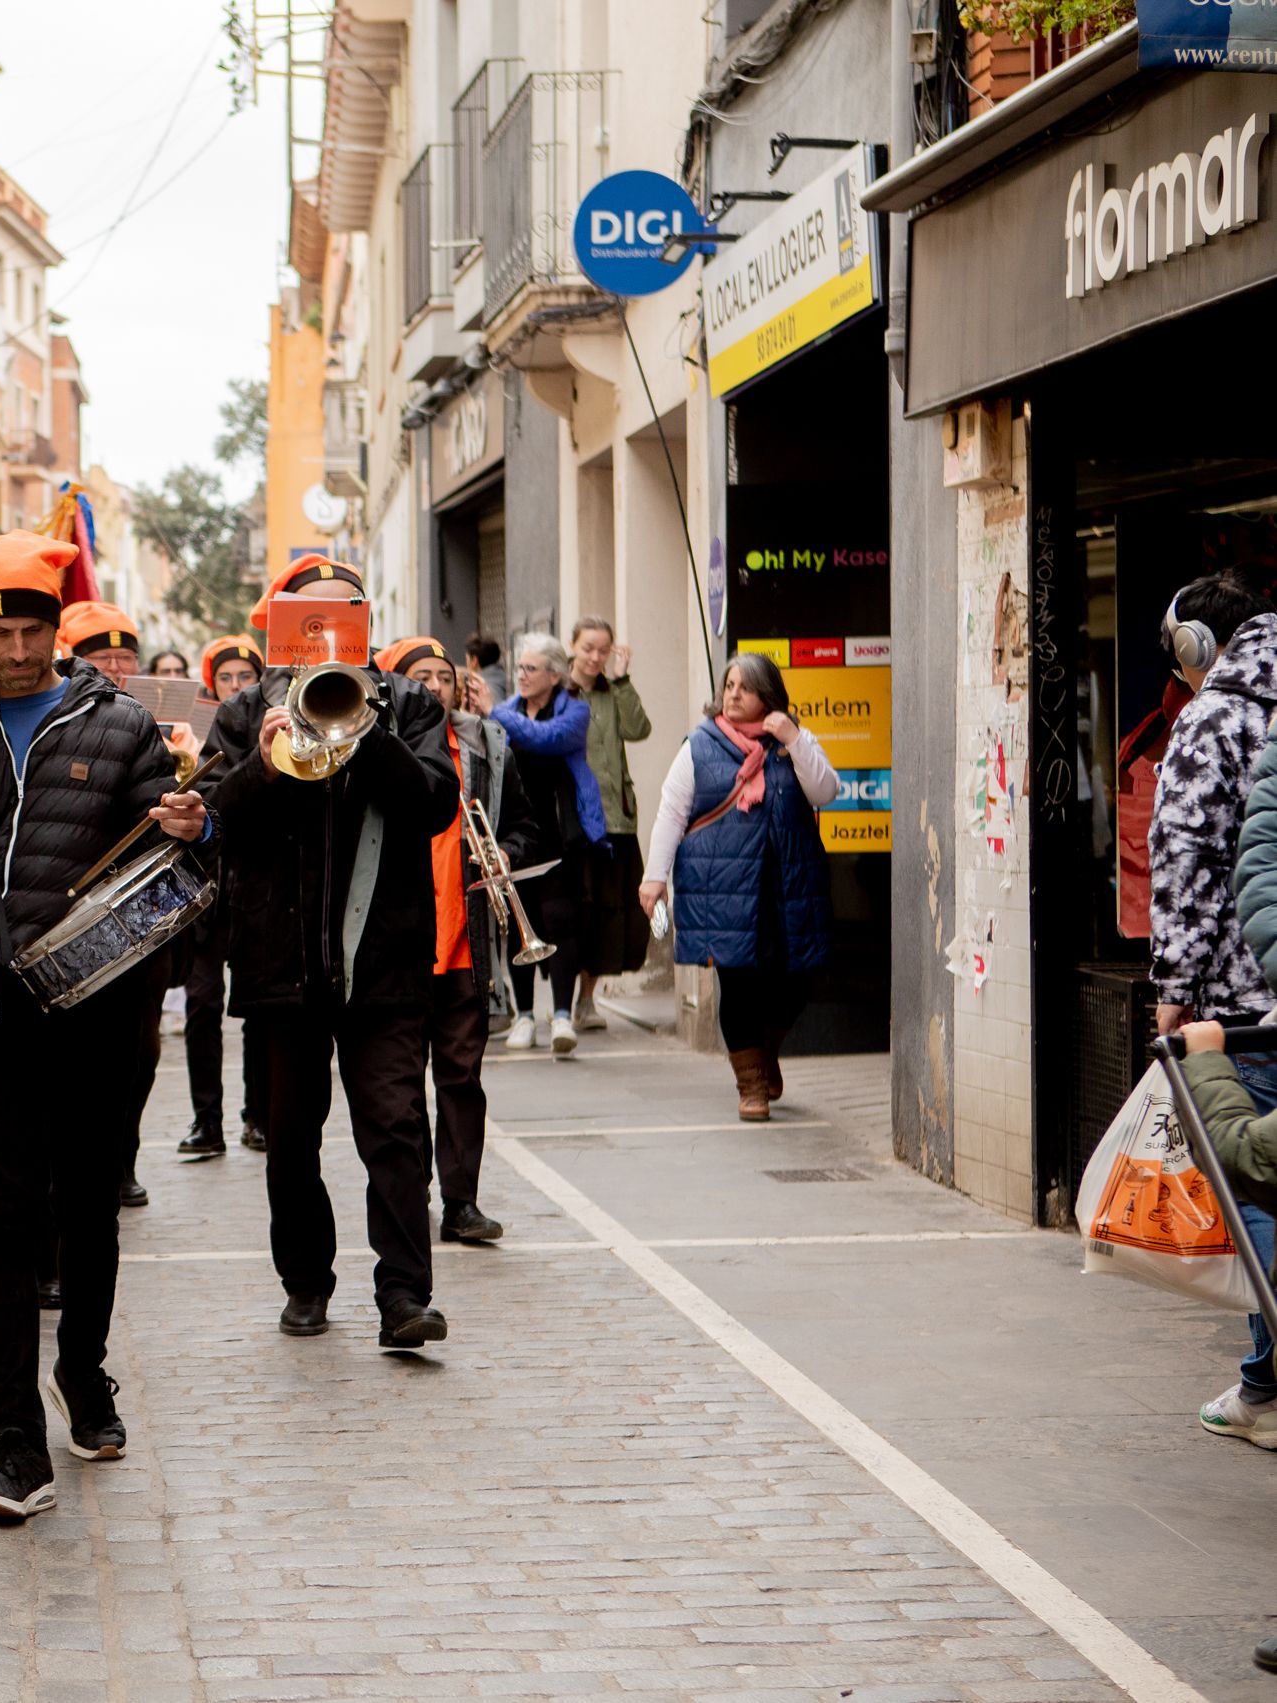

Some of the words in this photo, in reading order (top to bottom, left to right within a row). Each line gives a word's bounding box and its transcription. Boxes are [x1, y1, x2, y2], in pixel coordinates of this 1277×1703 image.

[1065, 112, 1270, 300] flormar
[590, 209, 683, 245] DIGI
[708, 269, 747, 332] LOCAL
[747, 254, 766, 307] EN
[764, 207, 827, 294] LLOGUER
[745, 549, 785, 571] Oh!
[792, 548, 826, 573] My
[833, 548, 888, 567] Kase
[270, 644, 364, 655] CONTEMPOANIA
[835, 780, 890, 801] DIGI
[830, 824, 890, 840] Jazztel
